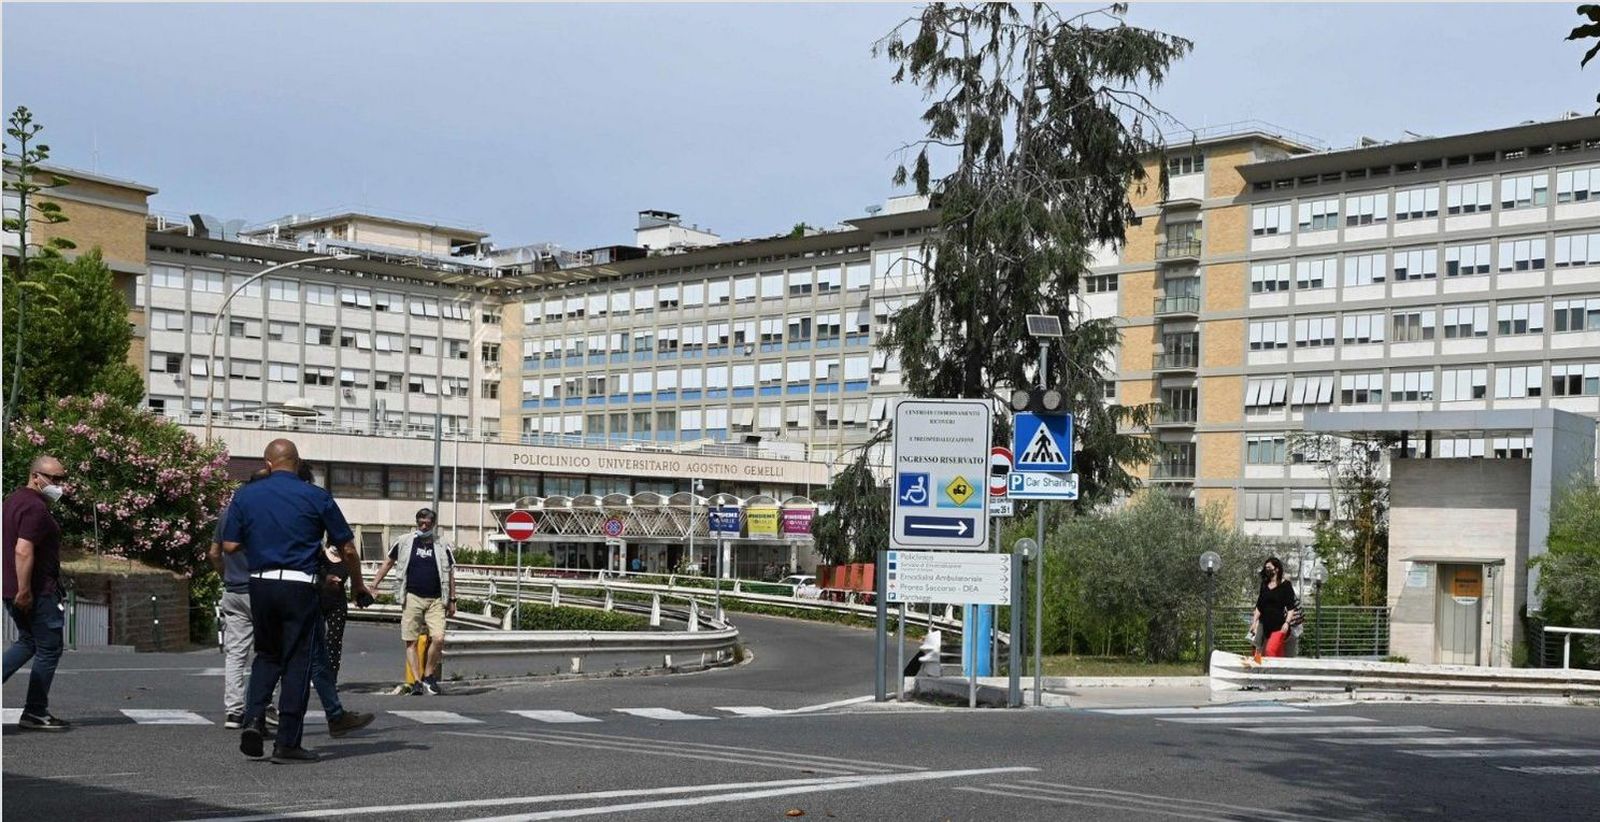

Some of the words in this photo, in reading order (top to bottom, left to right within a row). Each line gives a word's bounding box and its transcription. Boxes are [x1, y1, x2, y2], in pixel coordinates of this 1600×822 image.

[513, 453, 590, 468] POLICLINICO
[598, 457, 680, 472] UNIVERSITARIO
[686, 462, 738, 474] AGOSTINO
[743, 465, 784, 477] GEMELLI
[899, 455, 938, 463] INGRESSO
[940, 456, 984, 465] RISERVATO
[1011, 475, 1022, 490] P
[1026, 477, 1040, 487] Car
[1043, 477, 1076, 489] Sharing
[900, 583, 923, 591] Pronto
[925, 583, 956, 592] Soccorso
